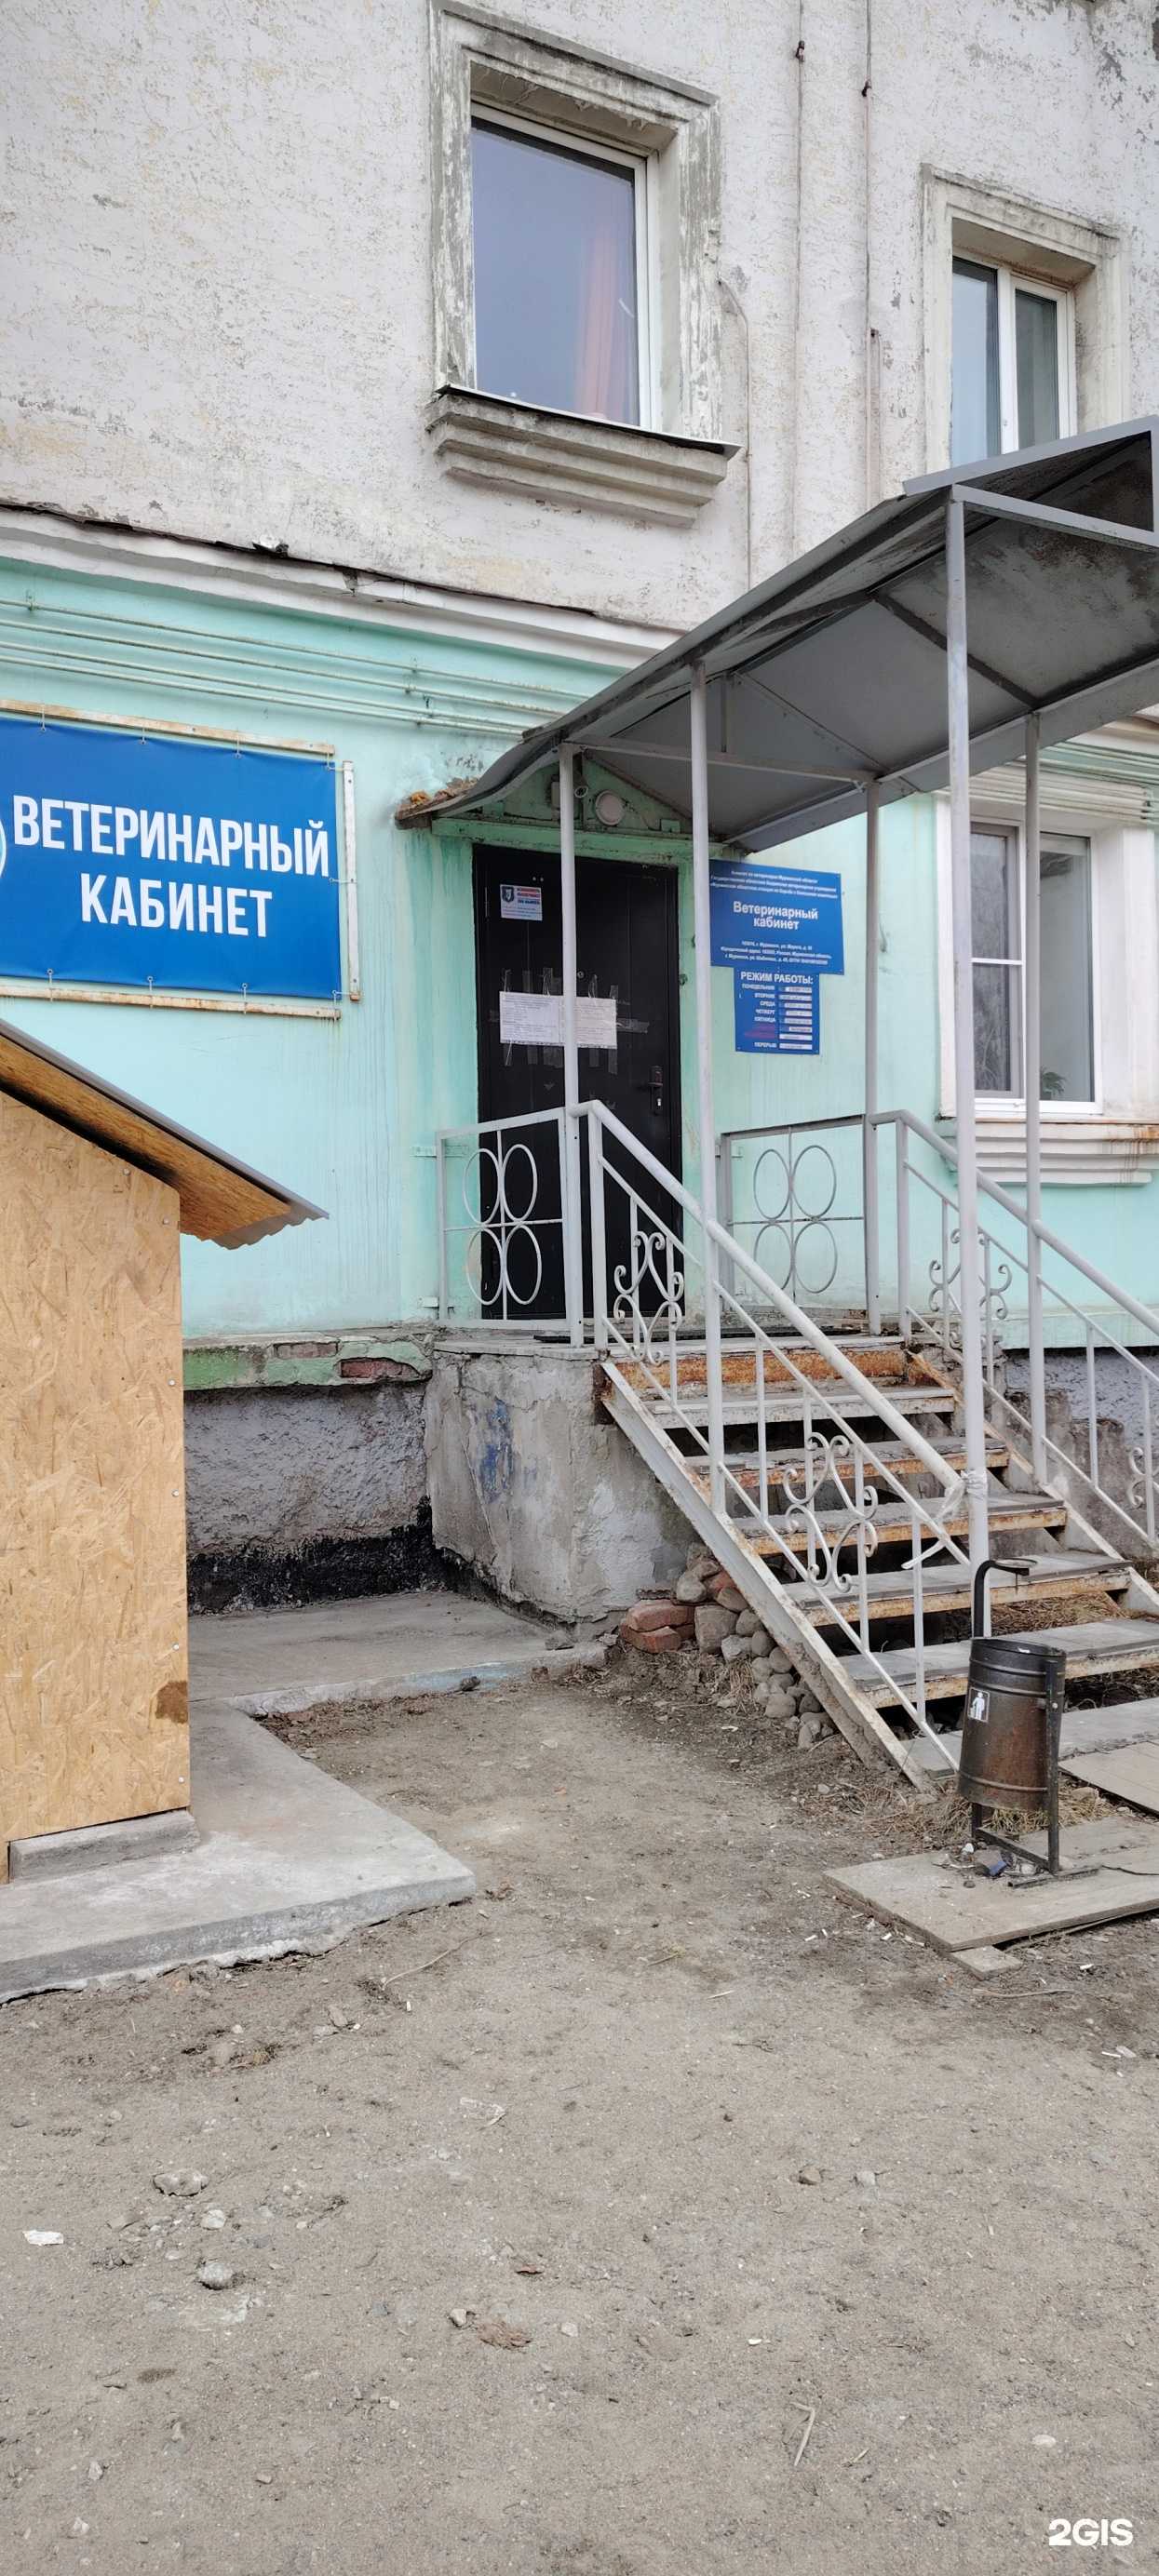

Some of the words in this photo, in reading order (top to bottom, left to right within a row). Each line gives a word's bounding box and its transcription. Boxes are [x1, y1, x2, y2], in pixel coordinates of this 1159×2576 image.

[13, 795, 329, 878] ВЕТЕРИНАРНЫЙ
[80, 872, 273, 938] КАБИНЕТ
[733, 901, 818, 919] Ветеринарный
[753, 917, 800, 930] кабинет
[740, 971, 773, 982] РЕЖИМ
[774, 973, 814, 985] РАБОТЫ:
